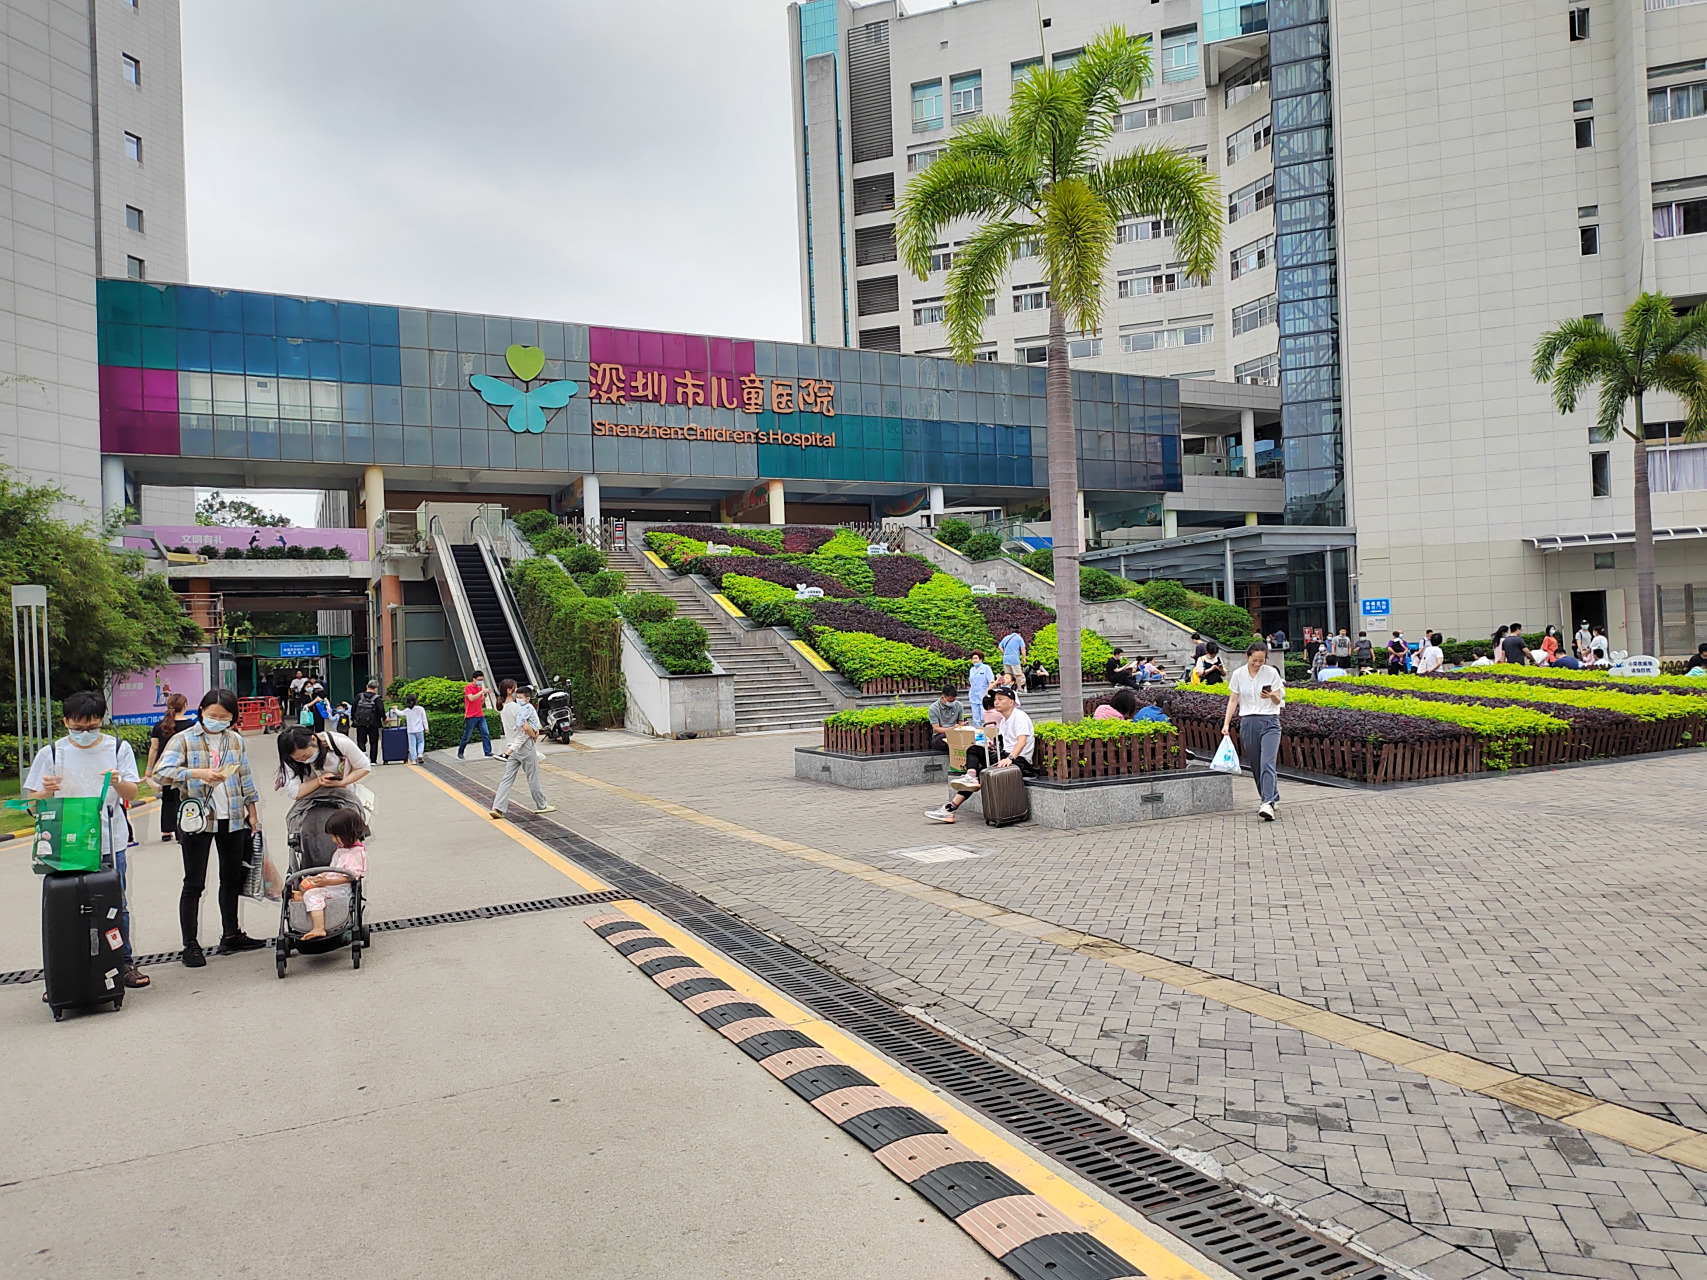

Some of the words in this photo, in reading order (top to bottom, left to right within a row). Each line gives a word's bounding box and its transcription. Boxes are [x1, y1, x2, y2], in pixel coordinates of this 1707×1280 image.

[589, 362, 835, 418] 深圳市儿童医院
[592, 420, 683, 441] Shenzhen
[683, 424, 768, 444] Children's
[769, 429, 837, 450] Hospital
[181, 534, 224, 545] 文明有礼
